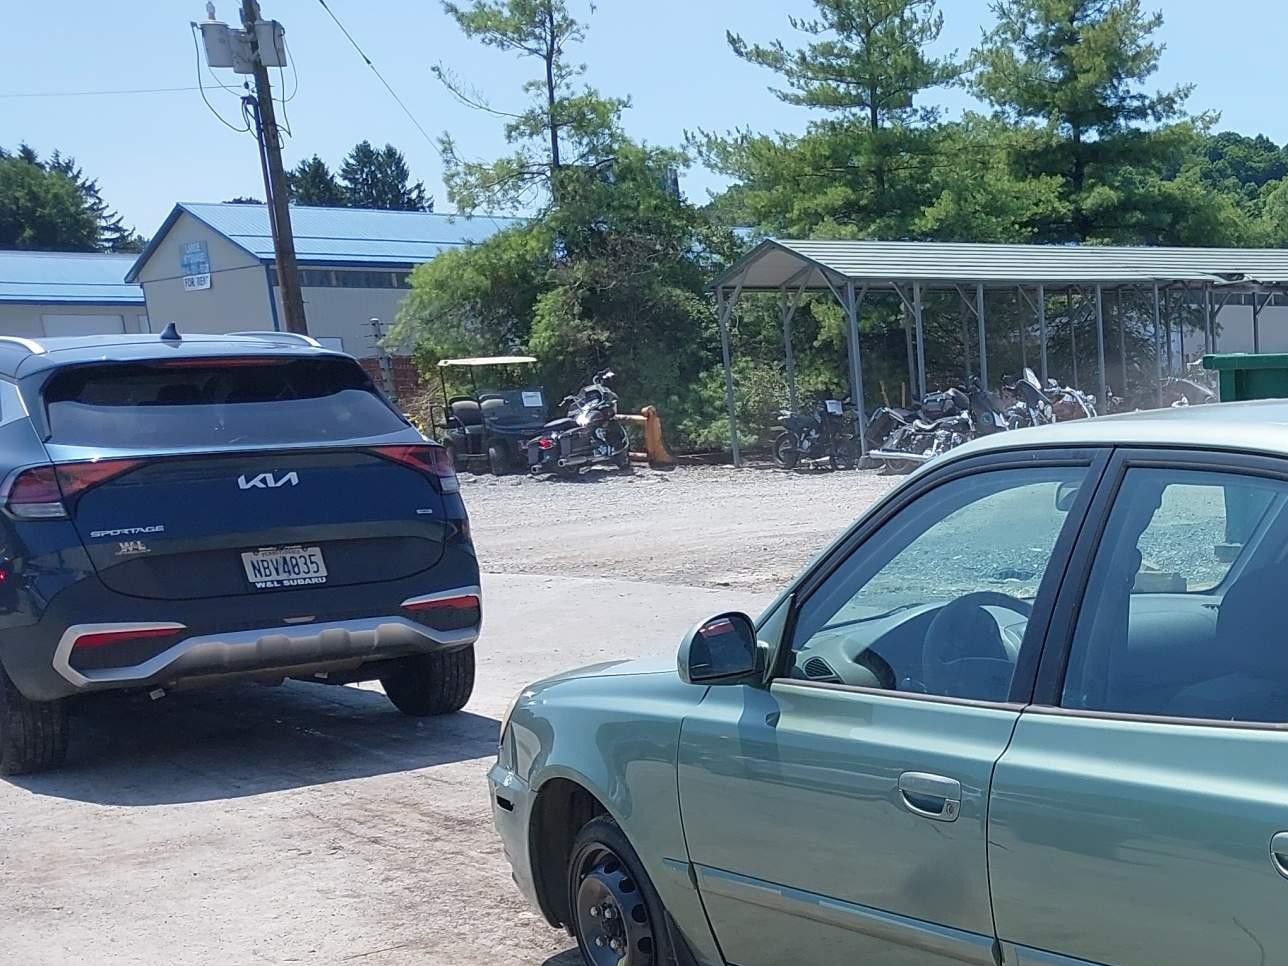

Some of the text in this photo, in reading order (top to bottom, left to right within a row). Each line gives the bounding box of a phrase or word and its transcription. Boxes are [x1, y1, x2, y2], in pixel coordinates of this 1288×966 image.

[238, 472, 299, 489] KIA
[90, 525, 164, 538] SPORTAGE
[255, 577, 327, 588] W&L SUBARU
